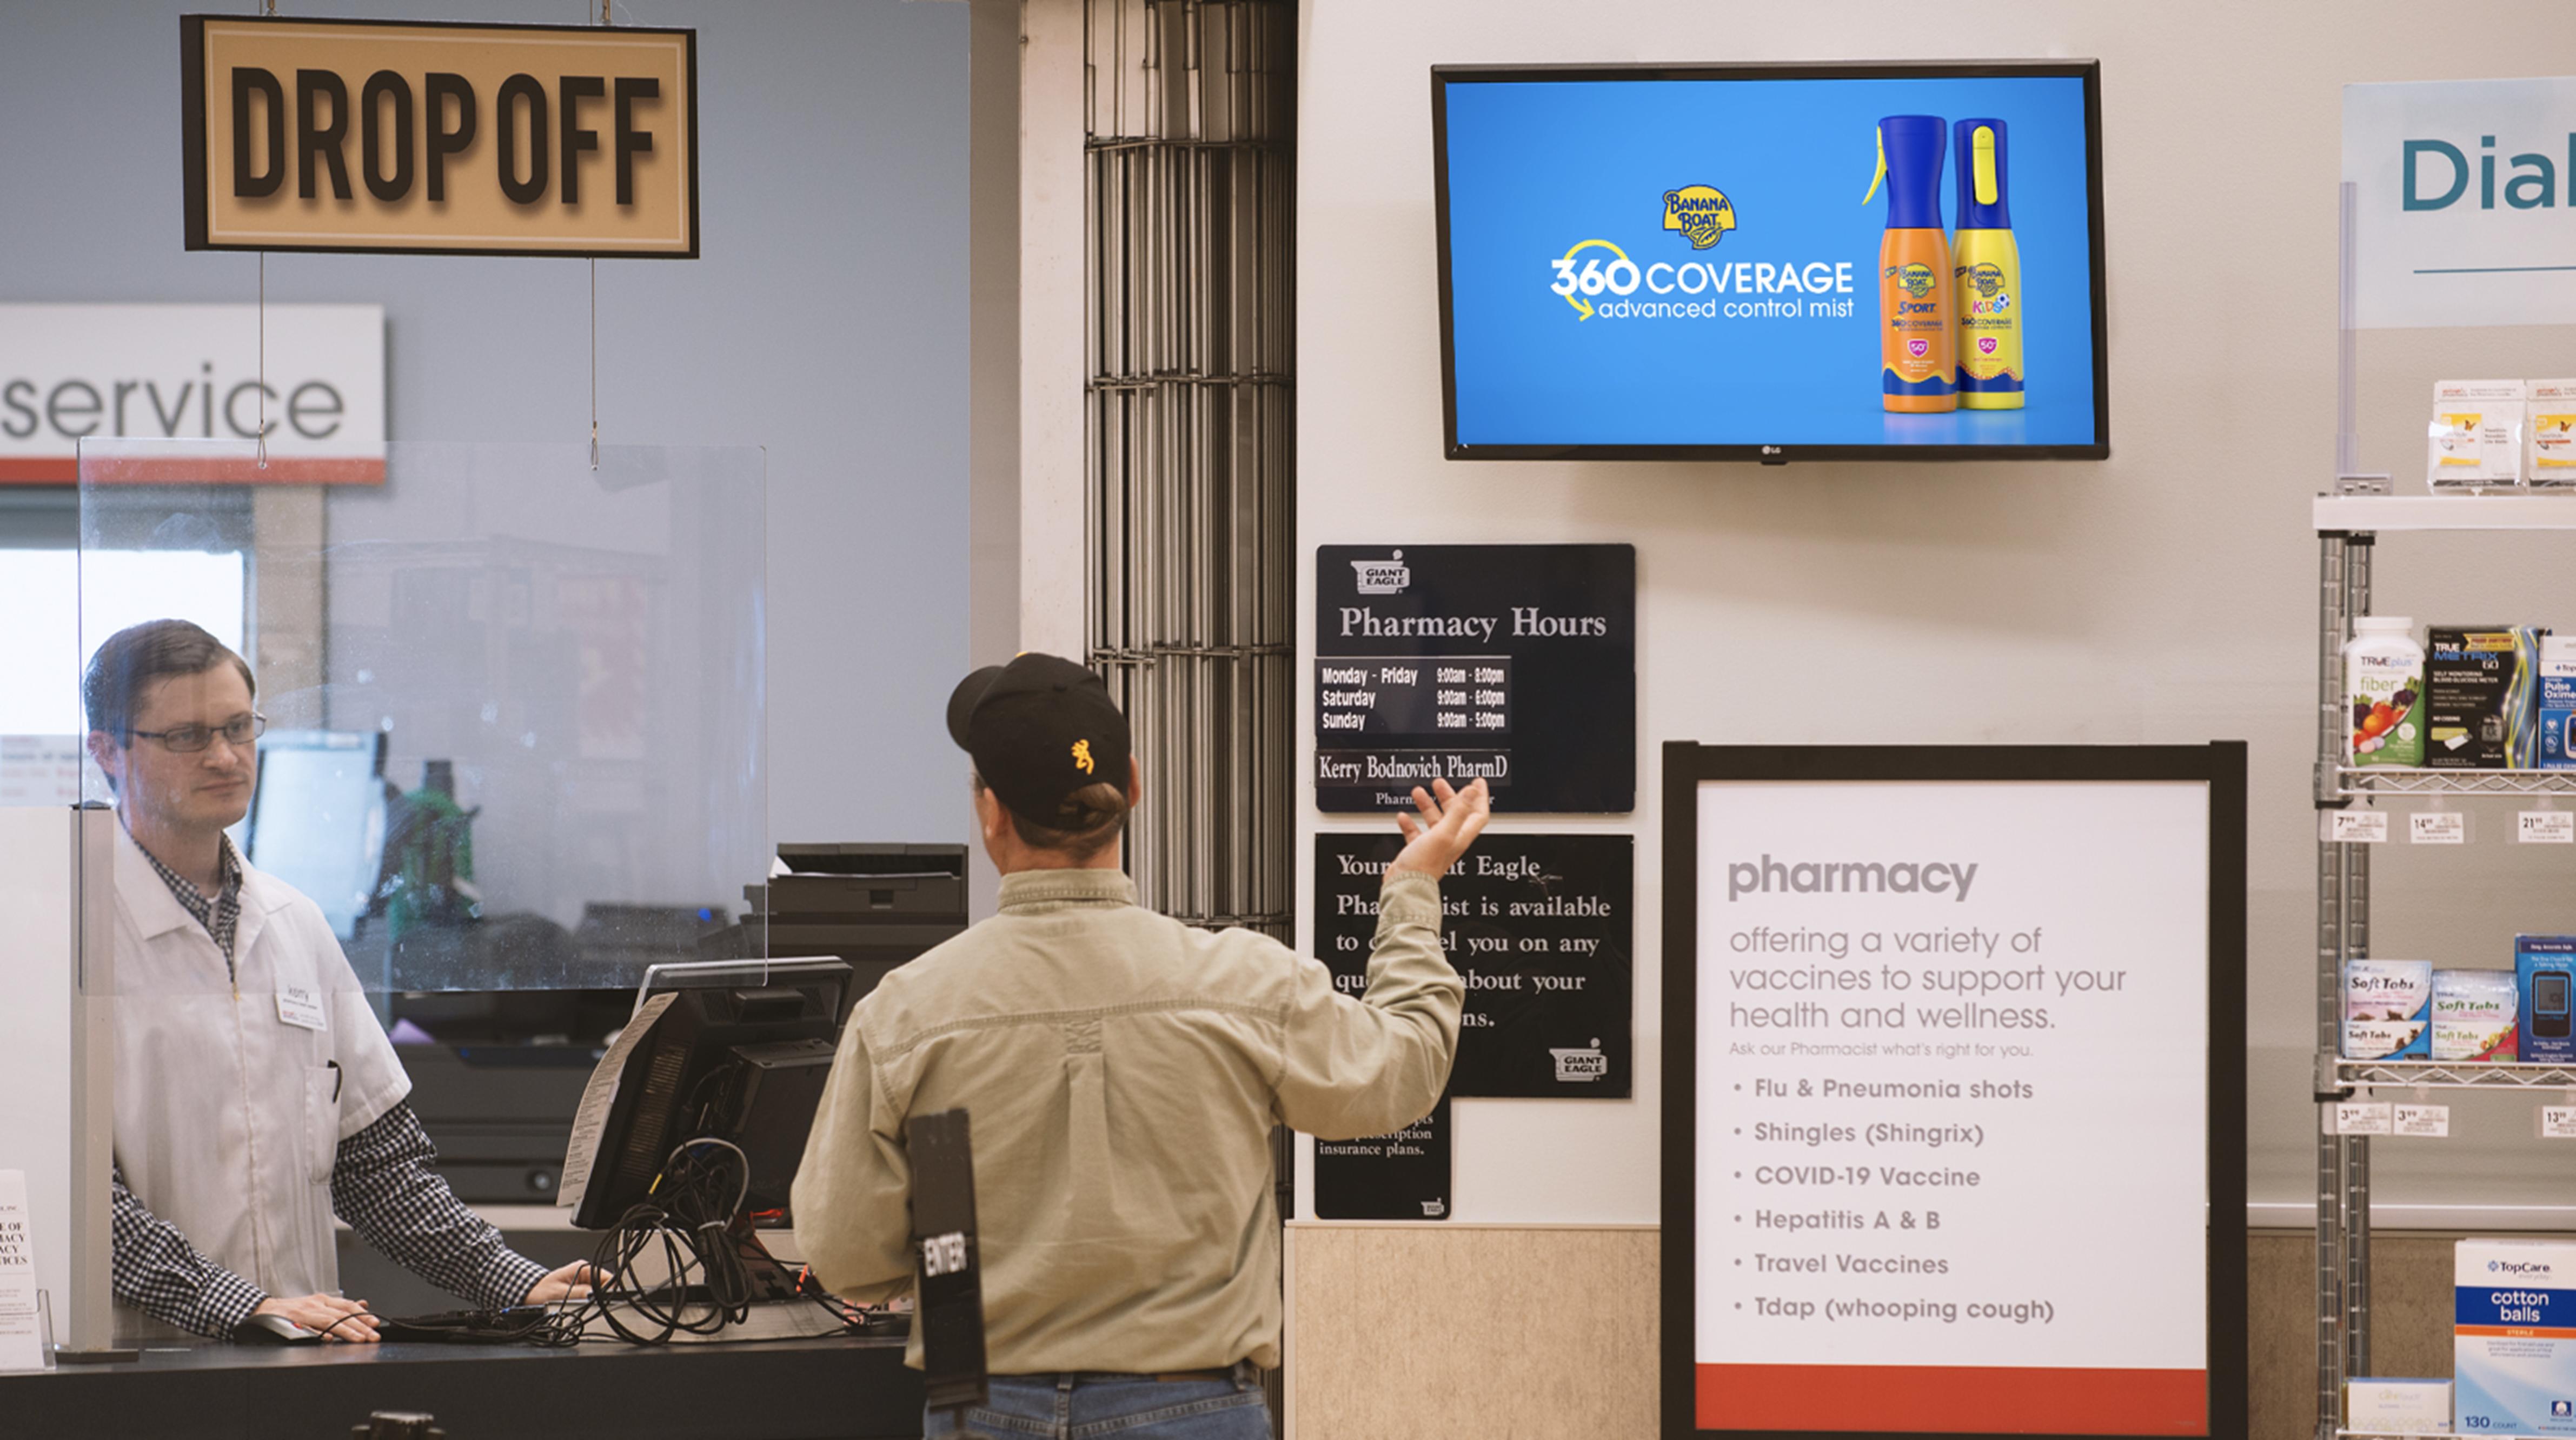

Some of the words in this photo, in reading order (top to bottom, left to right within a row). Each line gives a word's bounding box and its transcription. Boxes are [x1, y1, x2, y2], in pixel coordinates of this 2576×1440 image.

[231, 67, 477, 201] DROP
[496, 72, 660, 205] OFF
[2403, 132, 2576, 211] Dia
[1666, 193, 1729, 214] BANANA
[1677, 212, 1719, 234] BOAT
[1550, 259, 1641, 296] 360
[1646, 262, 1854, 294] COVERAGE
[1598, 299, 1716, 318] advanced
[1723, 299, 1802, 318] control
[1809, 299, 1854, 318] mist
[1898, 301, 1936, 315] SPORT
[0, 361, 344, 441] service
[1366, 569, 1405, 577] GIANT
[1366, 577, 1405, 585] EAGLE
[1339, 606, 1498, 643] Pharmacy
[1511, 606, 1607, 637] Hours
[2434, 642, 2460, 652] TRUE
[2434, 651, 2499, 661] METRIX
[1322, 667, 1368, 686] Monday
[1381, 667, 1418, 686] Friday
[1437, 667, 1466, 683] 9:00am
[2360, 676, 2398, 691] fiber
[2544, 683, 2571, 692] Pulse
[1322, 690, 1376, 709] Saturday
[1437, 690, 1466, 705] 9:00am
[1322, 712, 1366, 732] Sunday
[1437, 712, 1466, 728] 9:00am
[1475, 712, 1505, 730] 5:00pm
[1319, 756, 1362, 783] Kerry
[1366, 755, 1442, 778] Bodnovich
[1447, 755, 1508, 778] PharmD
[1336, 855, 1392, 875] Your
[1476, 856, 1541, 881] Eagle
[1729, 854, 1979, 902] pharmacy
[1336, 895, 1470, 916] Phaist
[1480, 896, 1499, 916] is
[1509, 895, 1611, 917] available
[1336, 934, 1359, 951] to
[1468, 936, 1509, 956] you
[1519, 936, 1549, 952] on
[1559, 936, 1601, 956] any
[1730, 926, 1849, 959] offering
[1861, 932, 1882, 953] a
[1894, 926, 2000, 958] variety
[2010, 926, 2042, 953] of
[1458, 969, 1522, 990] about
[1532, 975, 1586, 994] your
[1730, 964, 1872, 990] vaccines
[1881, 964, 1911, 990] to
[1922, 964, 2044, 996] support
[2055, 970, 2126, 996] your
[2351, 977, 2380, 992] Soft
[1730, 1002, 1829, 1029] health
[1840, 1002, 1905, 1028] and
[1916, 1002, 2056, 1029] wellness.
[2436, 1000, 2465, 1013] Soft
[2348, 1031, 2367, 1041] Soft
[1564, 1056, 1602, 1064] GIANT
[1729, 1042, 1756, 1057] Ask
[1761, 1045, 1786, 1057] our
[1791, 1042, 1877, 1057] Pharmacist
[1882, 1042, 1931, 1057] what's
[1936, 1042, 1971, 1059] right
[1974, 1042, 1995, 1057] for
[2000, 1045, 2034, 1059] you.
[1564, 1064, 1602, 1074] EAGLE
[1755, 1079, 1788, 1098] Flu
[1796, 1079, 1814, 1098] &
[1823, 1079, 1961, 1099] Pneumonia
[1969, 1080, 2034, 1099] shots
[1755, 1122, 1856, 1146] Shingles
[1865, 1123, 1985, 1148] (Shingrix)
[1319, 1142, 1382, 1155] insurance
[1386, 1142, 1425, 1158] plans.
[1755, 1166, 1871, 1186] COVID-19
[1880, 1166, 1981, 1187] Vaccine
[1755, 1210, 1864, 1232] Hepatitis
[1874, 1211, 1890, 1230] A
[1899, 1211, 1917, 1230] &
[1926, 1211, 1941, 1230] B
[1755, 1254, 1827, 1273] Travel
[1836, 1254, 1949, 1275] Vaccines
[2500, 1261, 2551, 1274] TopCare
[2491, 1290, 2550, 1306] cotton
[1755, 1297, 1815, 1320] Tdap
[1825, 1298, 1957, 1323] (whooping
[1967, 1299, 2055, 1324] cough)
[2500, 1305, 2540, 1322] balls
[2506, 1329, 2534, 1337] STERILE
[2465, 1416, 2491, 1428] 130
